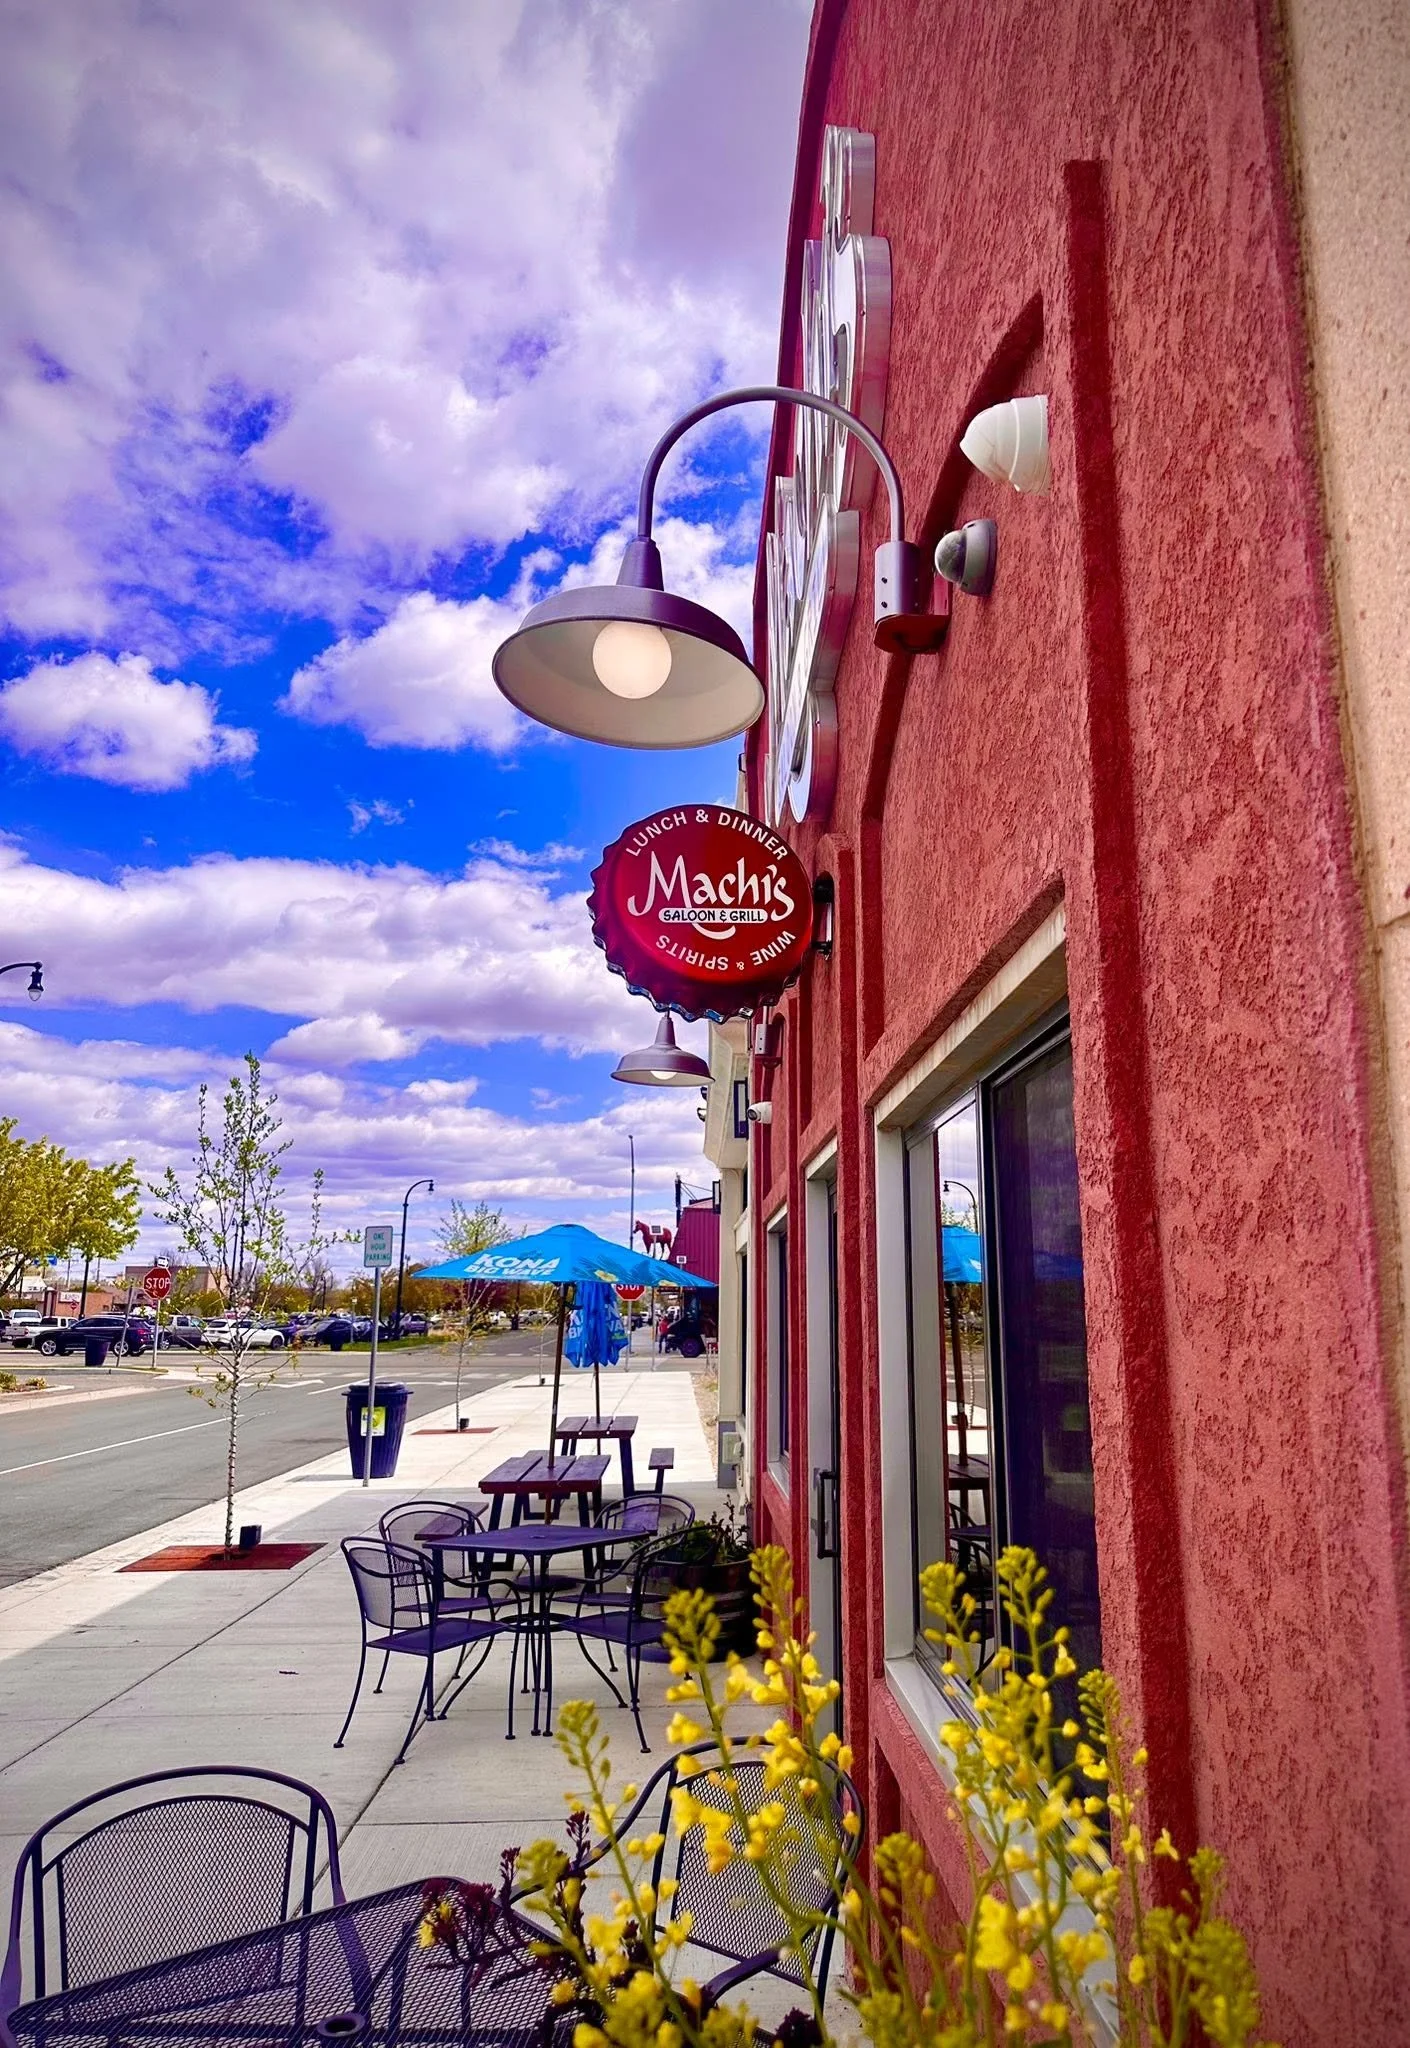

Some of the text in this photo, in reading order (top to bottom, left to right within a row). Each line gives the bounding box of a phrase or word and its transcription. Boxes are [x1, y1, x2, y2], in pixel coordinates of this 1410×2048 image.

[626, 809, 788, 861] LUNCH & DINNER
[627, 851, 795, 939] Machi's
[663, 908, 764, 923] SALOON & GRILL
[655, 930, 796, 971] WINE & SPIRITS
[366, 1253, 391, 1261] PARKING
[473, 1254, 560, 1269] KONA
[463, 1264, 555, 1276] BIG WAVE
[145, 1277, 171, 1289] STOP
